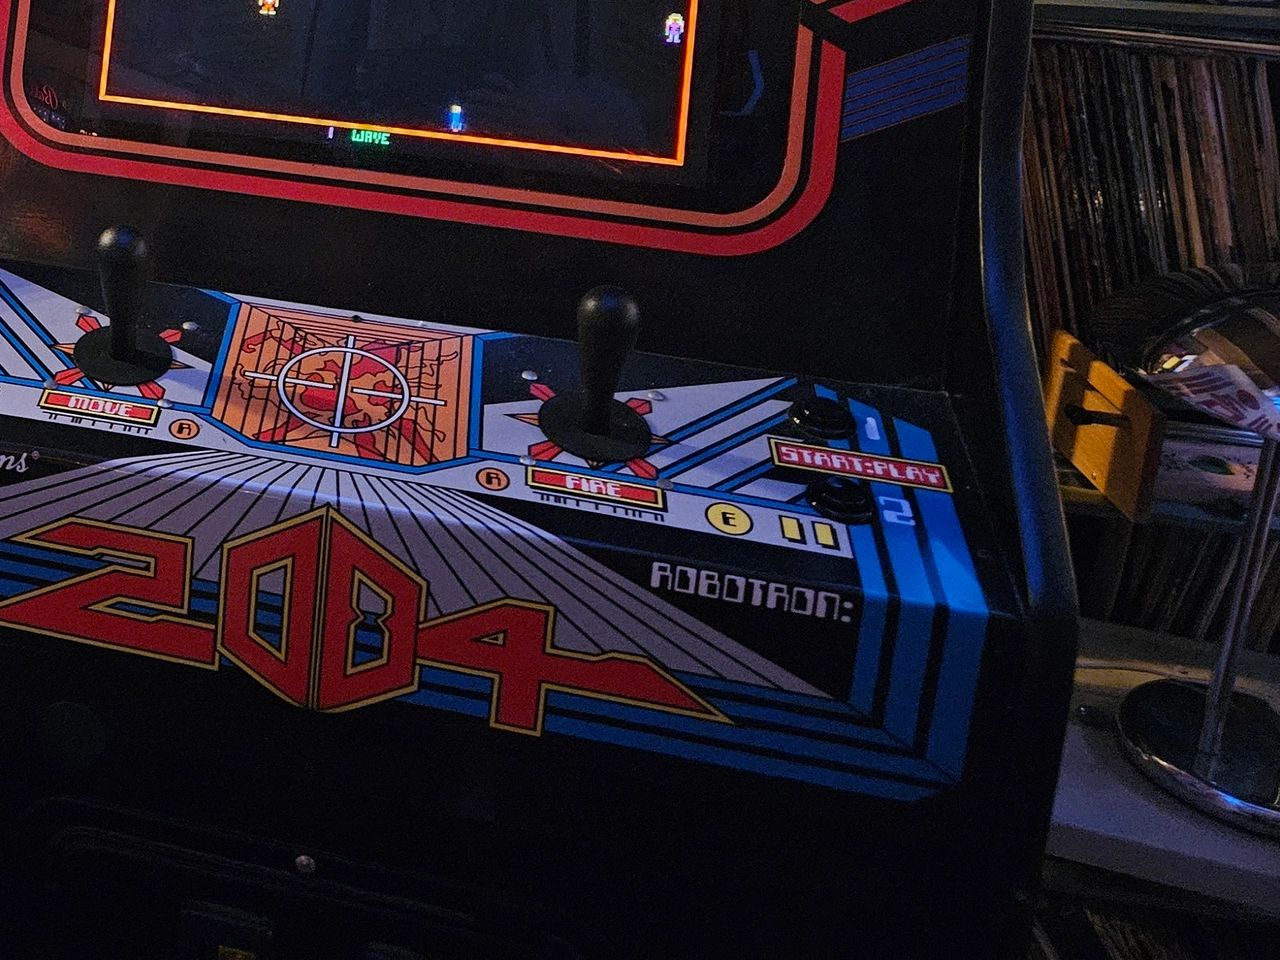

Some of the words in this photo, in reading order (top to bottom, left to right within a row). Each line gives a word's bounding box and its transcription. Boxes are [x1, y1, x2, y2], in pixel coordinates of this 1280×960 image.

[351, 128, 391, 146] WAVE
[67, 395, 134, 418] MOVE
[864, 416, 881, 441] 1
[779, 446, 941, 484] START:PLAY
[563, 474, 622, 497] FIRE
[878, 495, 917, 527] 2
